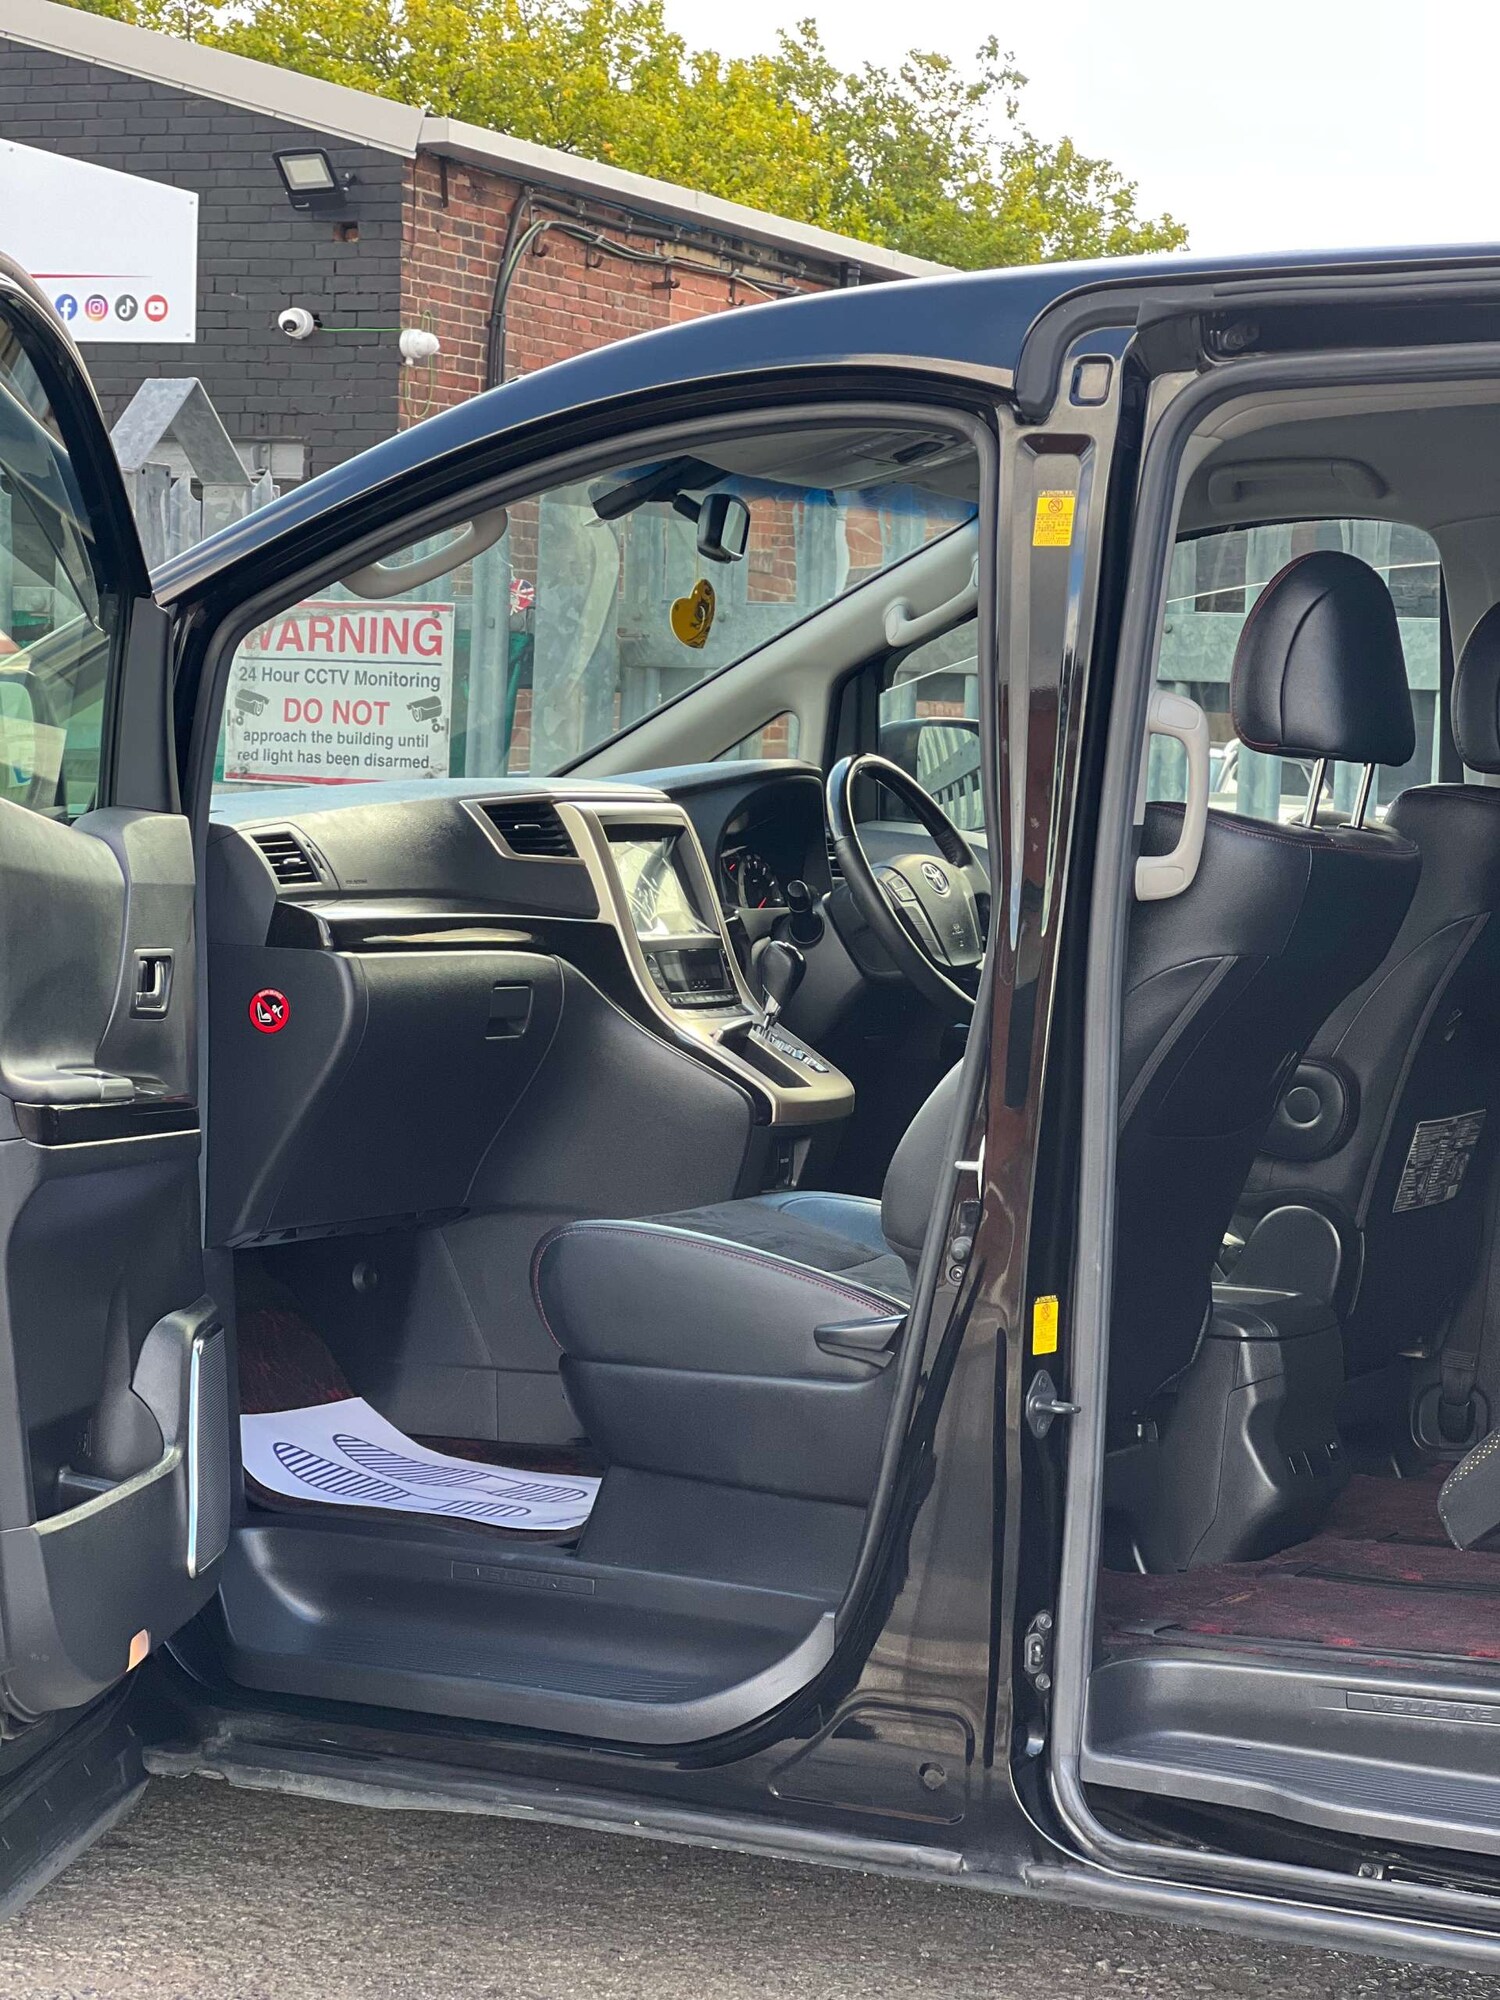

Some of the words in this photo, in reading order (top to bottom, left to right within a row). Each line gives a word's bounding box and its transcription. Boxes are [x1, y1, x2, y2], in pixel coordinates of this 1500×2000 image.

[239, 667, 257, 682] 24
[262, 667, 300, 683] Hour
[304, 668, 349, 685] CCTV
[354, 670, 441, 691] Monitoring
[284, 698, 323, 724] DO
[332, 700, 390, 725] NOT
[243, 730, 307, 745] approach
[311, 731, 333, 745] the
[337, 732, 393, 750] building
[398, 735, 429, 748] until
[237, 749, 259, 761] red
[263, 749, 292, 765] light
[297, 750, 321, 764] has
[326, 752, 360, 767] been
[364, 754, 434, 769] disarmed.
[1371, 1697, 1492, 1719] VELLFIRE
